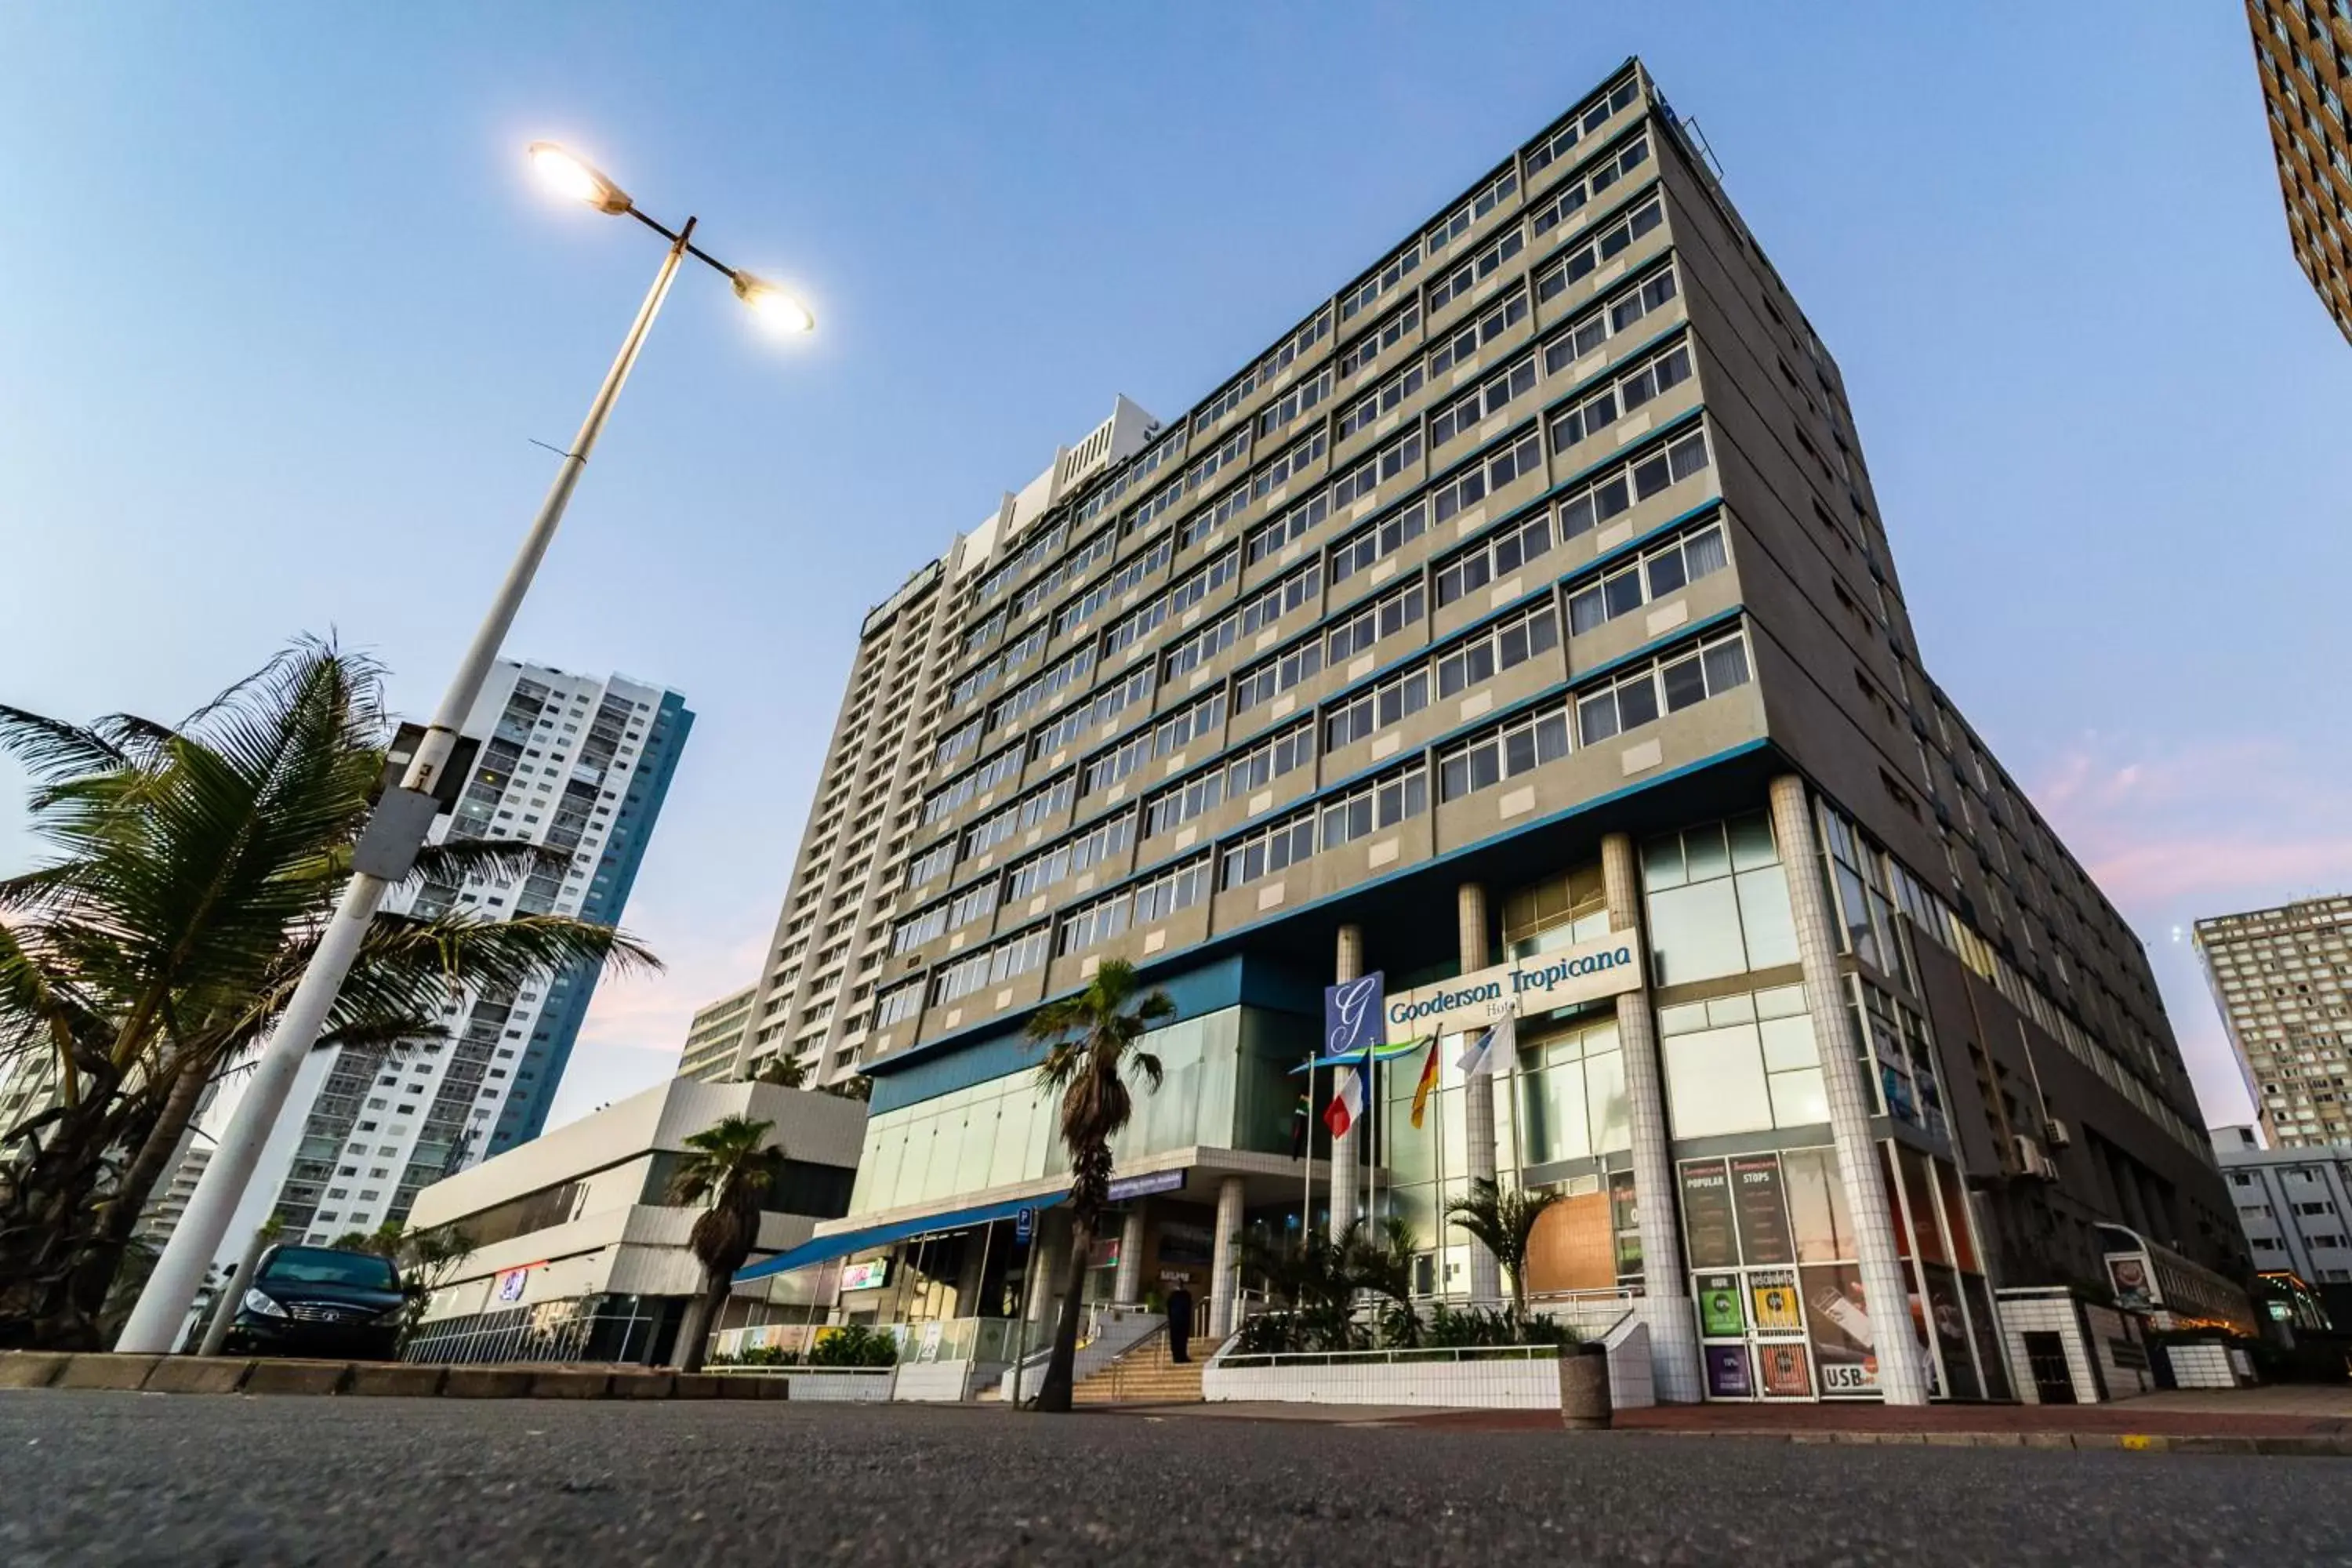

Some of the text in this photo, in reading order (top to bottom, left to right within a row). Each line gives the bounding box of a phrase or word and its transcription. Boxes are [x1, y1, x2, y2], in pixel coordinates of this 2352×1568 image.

[1390, 946, 1632, 1024] Gooderson Tropicana
[1686, 1172, 1769, 1189] POPULAR STOPS
[1826, 1367, 1861, 1387] USB
